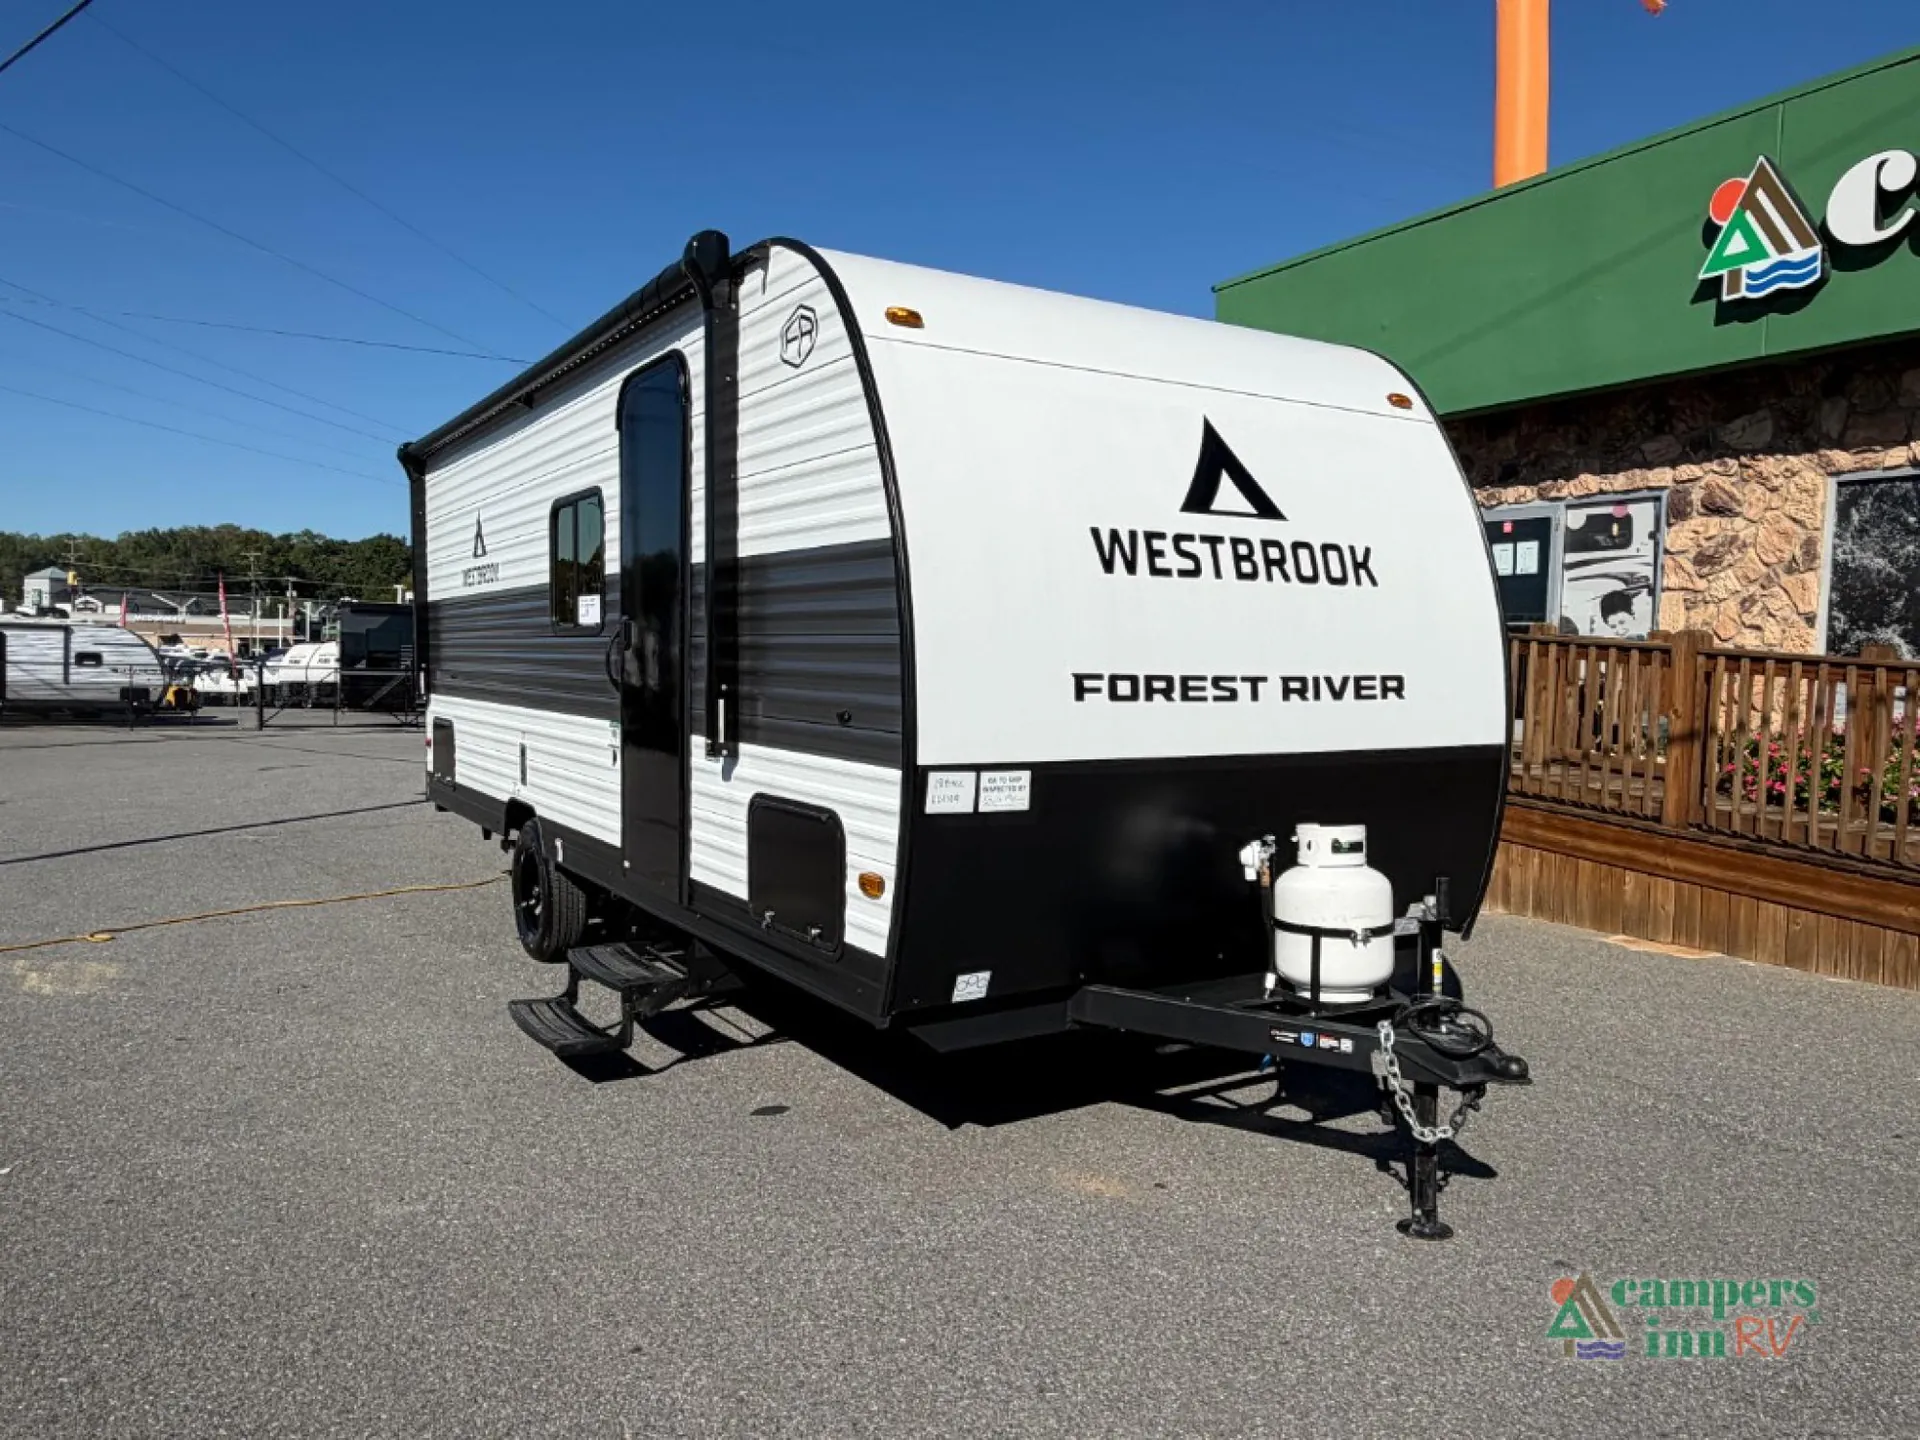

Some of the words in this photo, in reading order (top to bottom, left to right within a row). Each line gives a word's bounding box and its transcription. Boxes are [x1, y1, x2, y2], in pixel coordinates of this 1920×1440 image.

[1089, 526, 1379, 588] WESTBROOK
[1070, 672, 1268, 702] FOREST
[1279, 674, 1406, 701] RIVER
